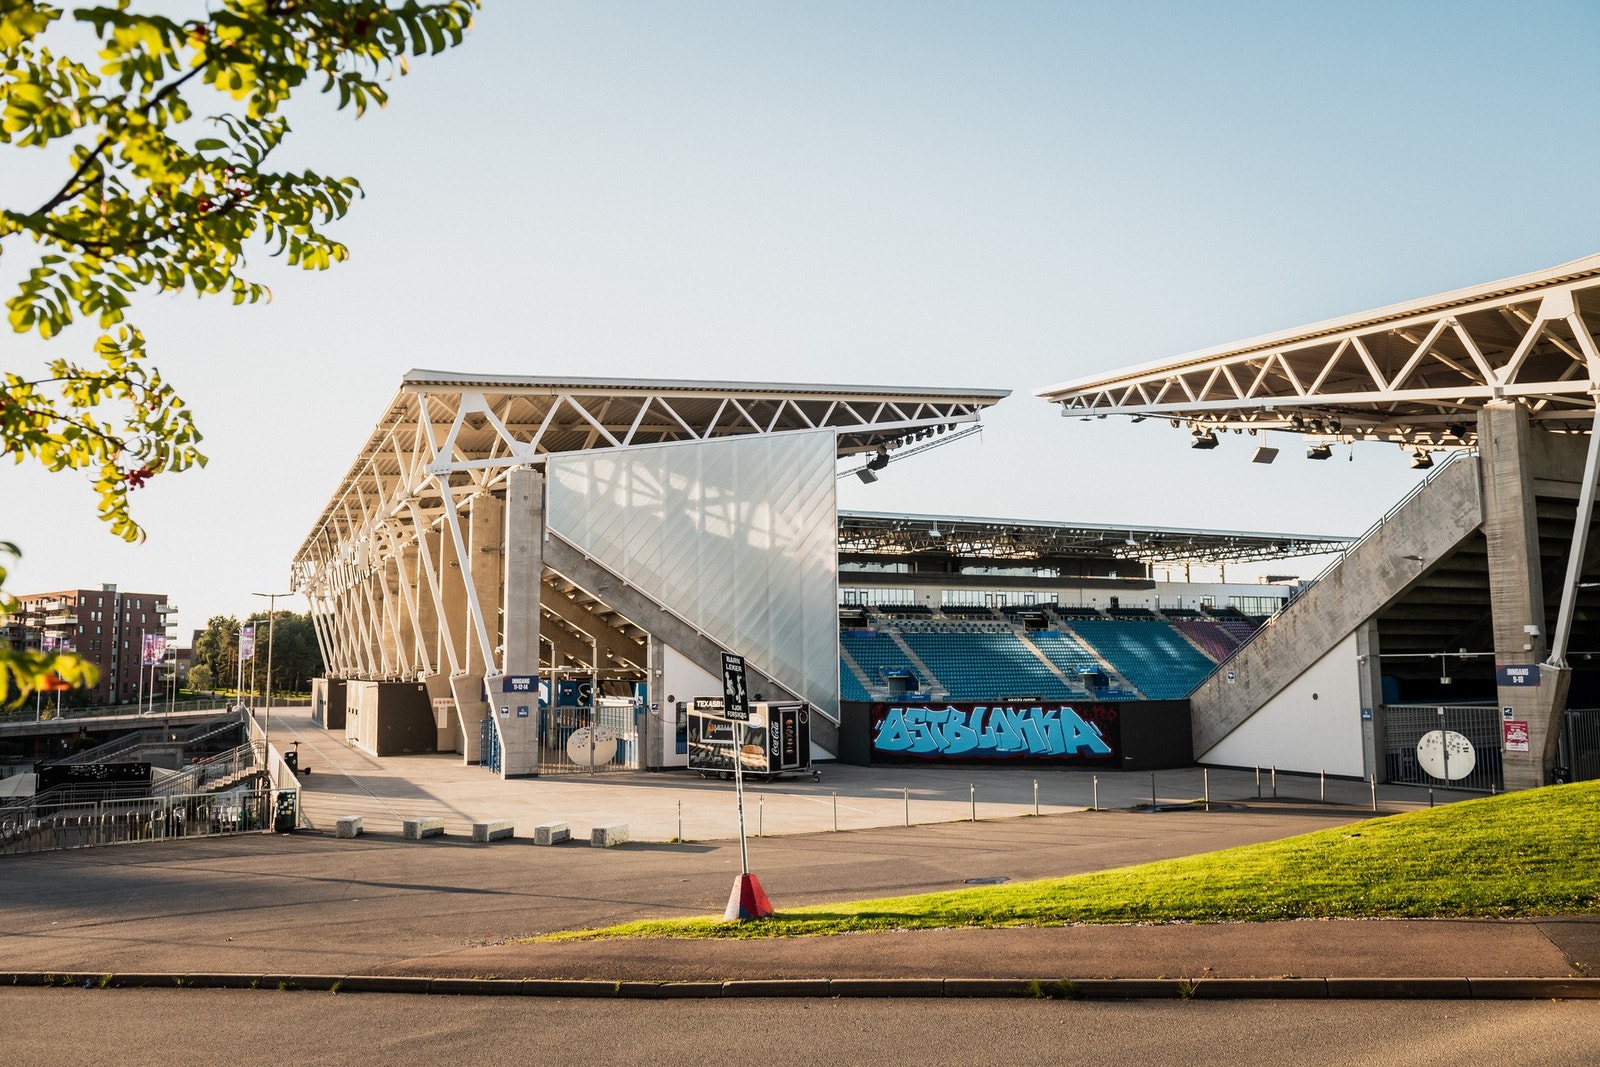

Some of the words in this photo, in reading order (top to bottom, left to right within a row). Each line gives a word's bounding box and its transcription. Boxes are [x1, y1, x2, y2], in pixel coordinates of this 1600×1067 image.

[726, 656, 740, 664] BARN
[725, 664, 742, 672] LEKER
[1506, 668, 1529, 676] INNGANG
